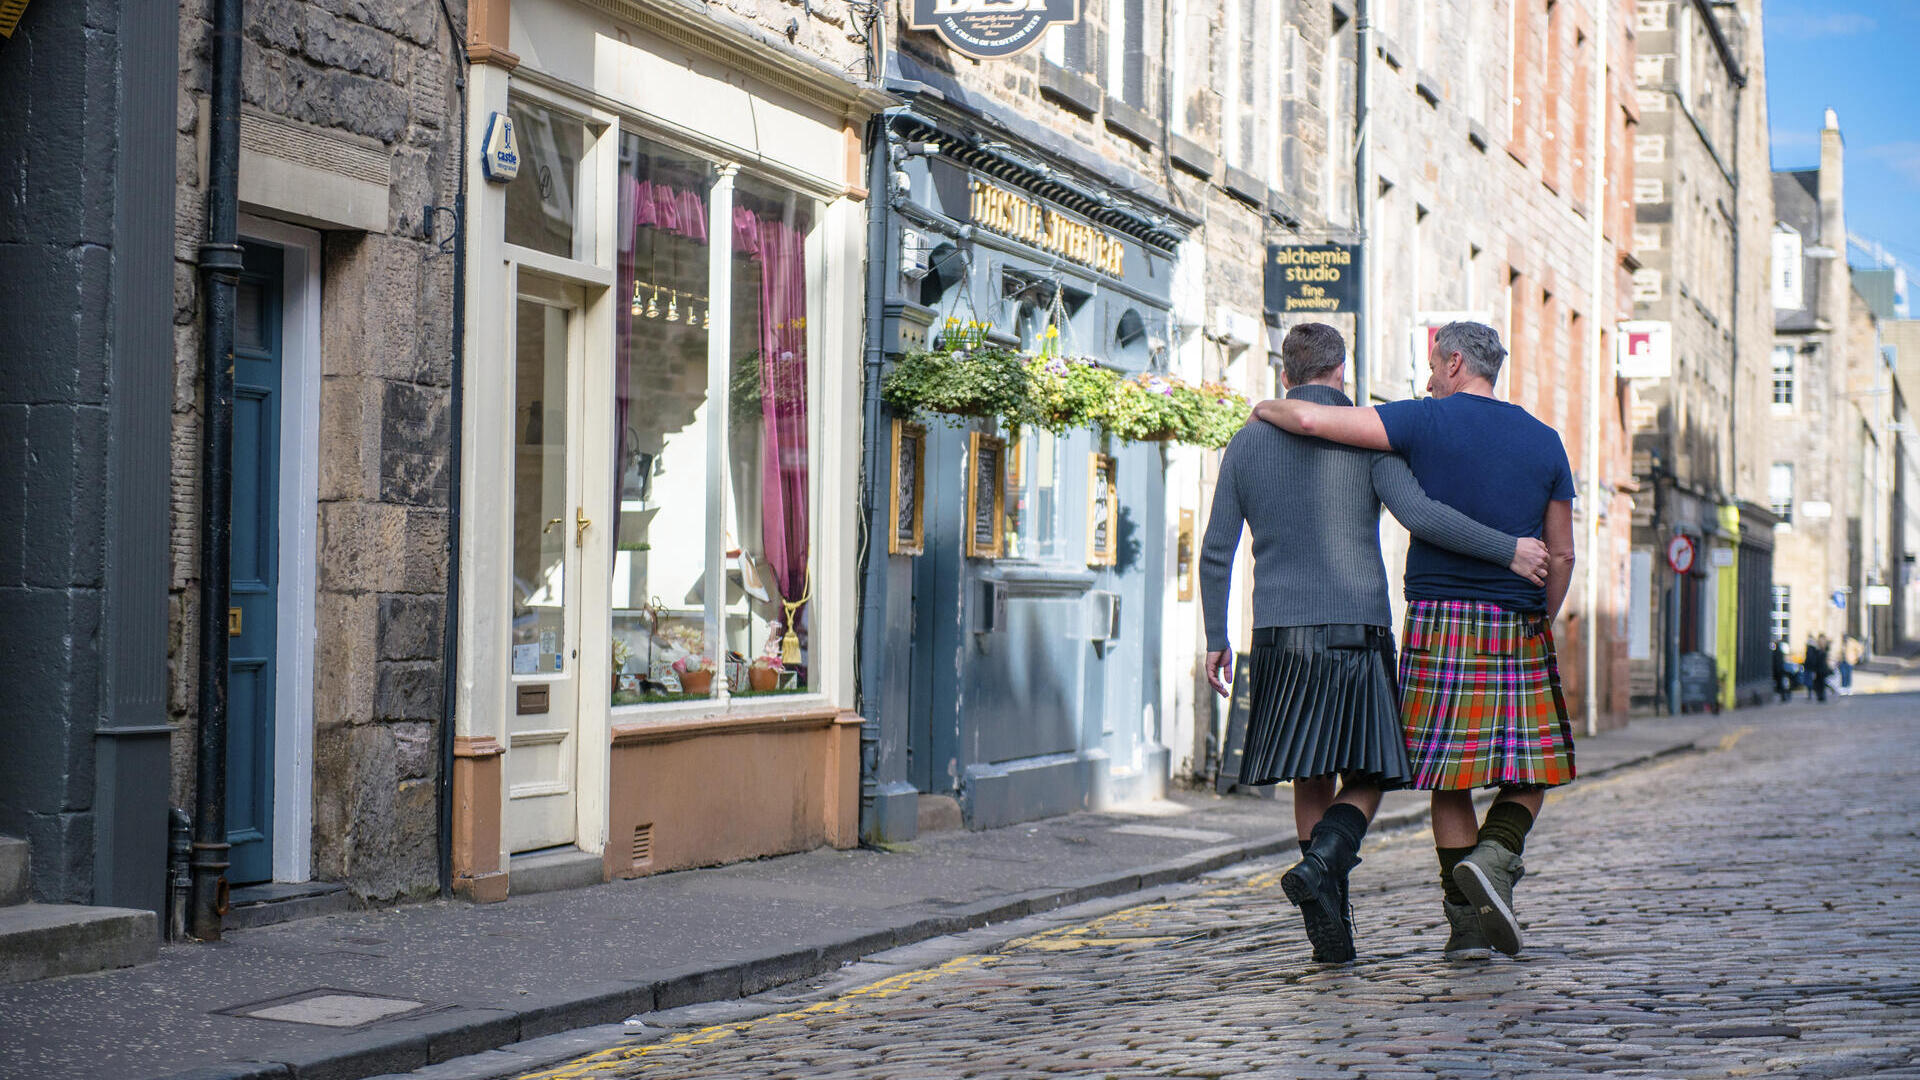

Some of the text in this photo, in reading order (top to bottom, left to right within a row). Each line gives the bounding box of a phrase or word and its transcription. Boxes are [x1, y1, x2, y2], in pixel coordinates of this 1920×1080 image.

[497, 151, 517, 164] castle
[1276, 246, 1351, 265] alchemia
[1285, 264, 1341, 282] studio
[1301, 284, 1325, 296] fine
[1285, 295, 1340, 311] jewellery
